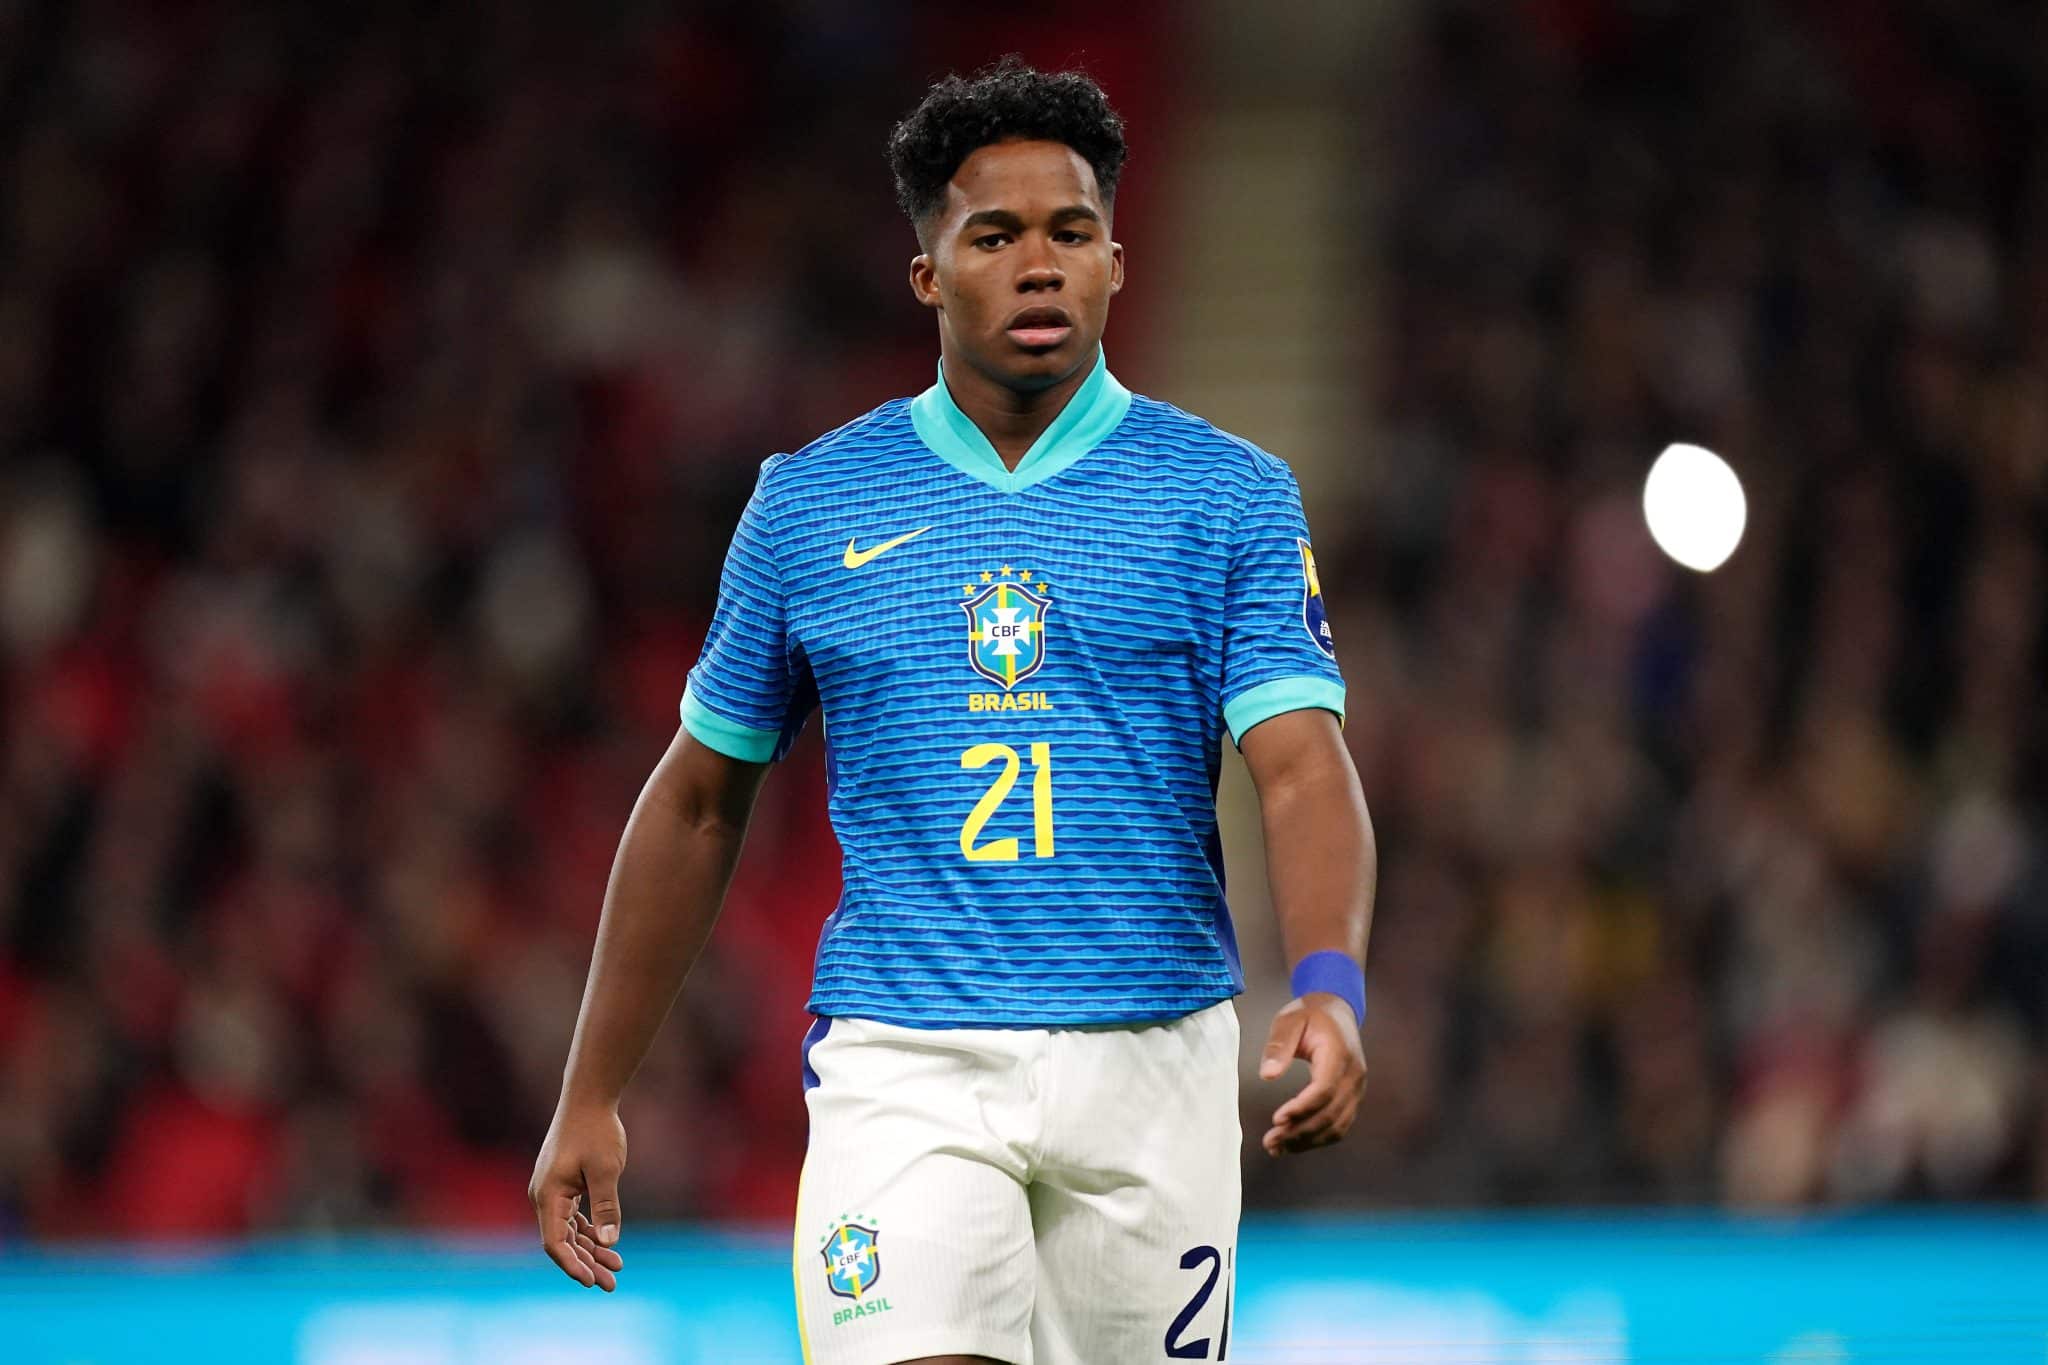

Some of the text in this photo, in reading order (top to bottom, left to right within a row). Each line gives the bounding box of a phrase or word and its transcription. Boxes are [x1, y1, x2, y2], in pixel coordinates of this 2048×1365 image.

[992, 626, 1020, 637] CBF
[968, 692, 1053, 712] BRASIL
[960, 742, 1054, 861] 21
[840, 1252, 860, 1266] CBF
[833, 1298, 893, 1326] BRASIL
